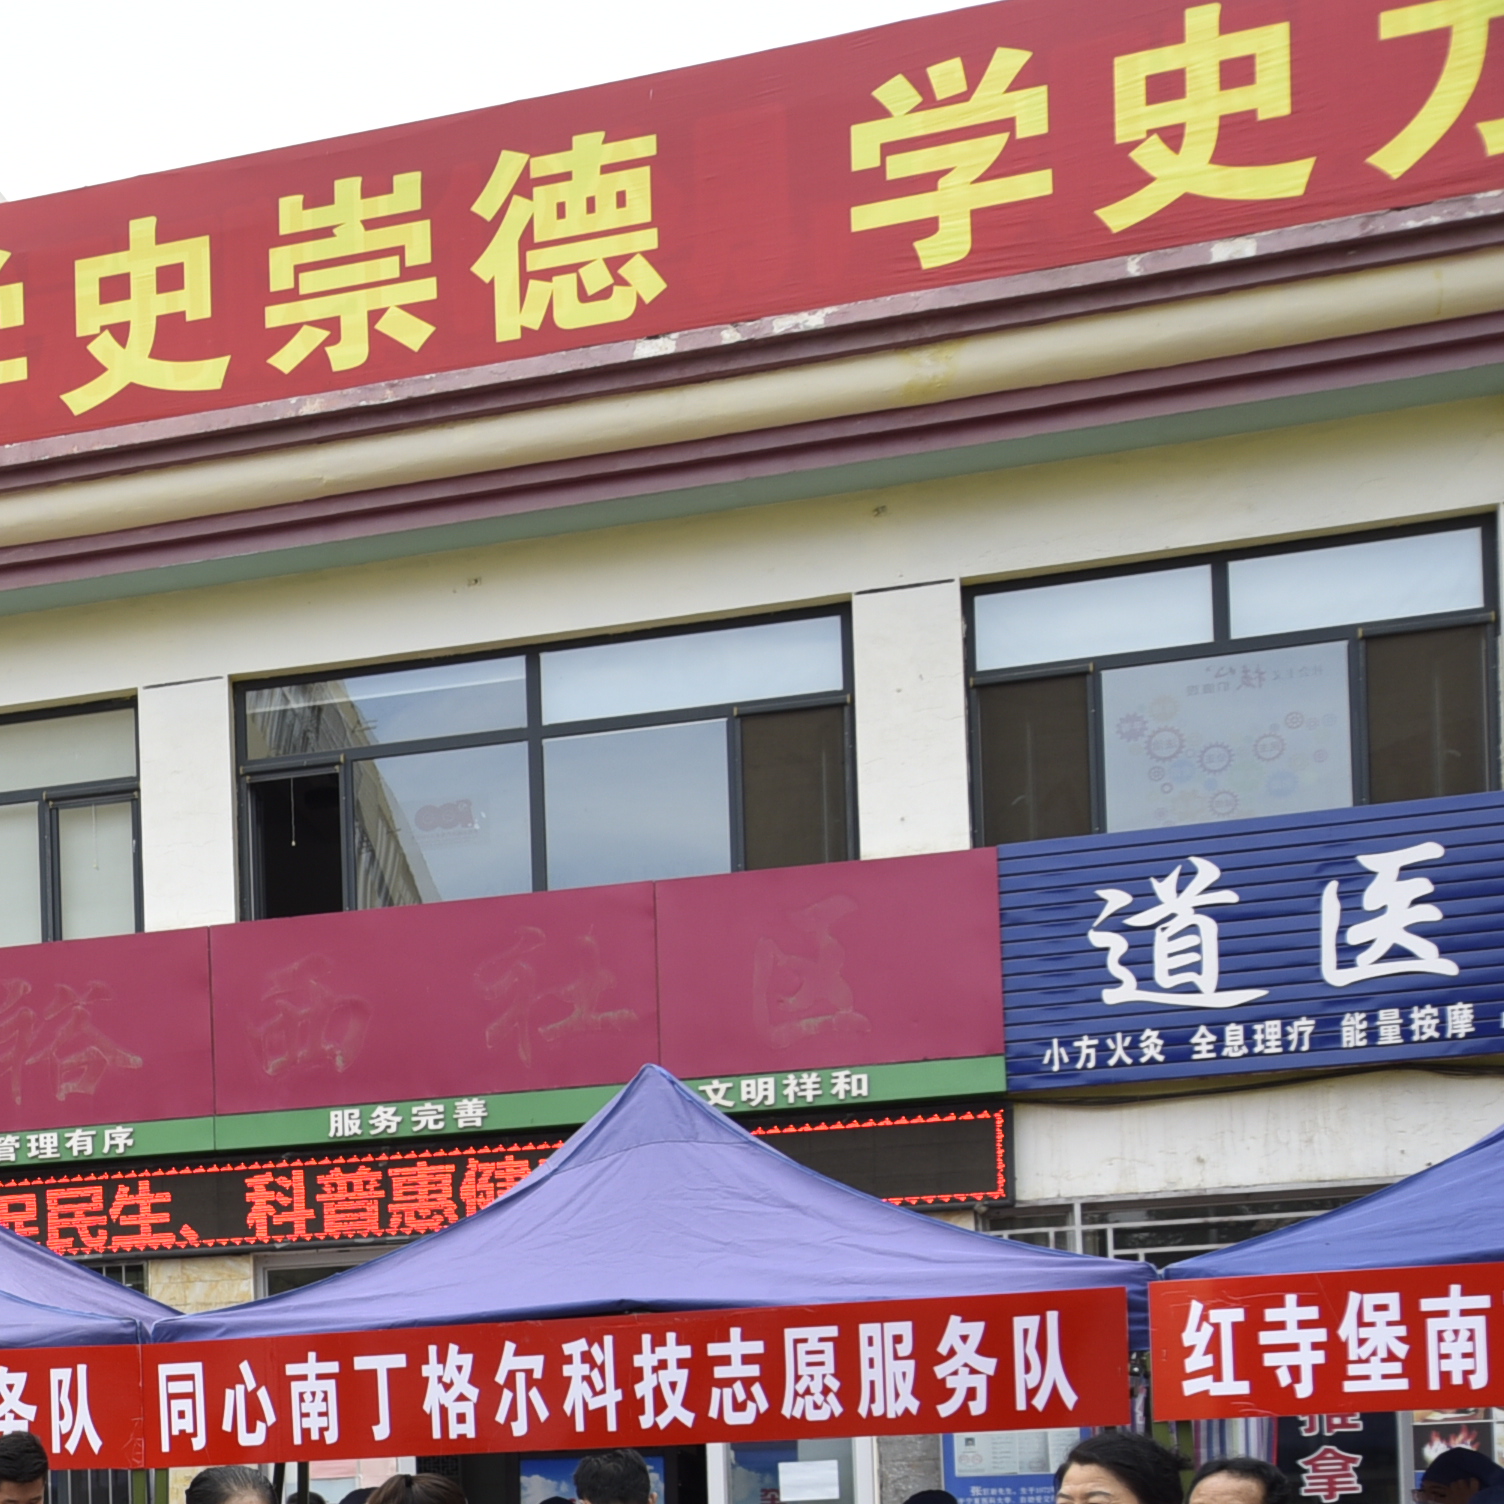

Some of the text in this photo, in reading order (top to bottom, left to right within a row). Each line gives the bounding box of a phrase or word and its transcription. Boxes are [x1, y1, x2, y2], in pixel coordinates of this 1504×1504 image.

[1088, 841, 1460, 1008] 道医
[1043, 1002, 1475, 1072] 小方火灸 全息理疗 能量按摩
[328, 1097, 489, 1138] 服务完善
[698, 1070, 869, 1108] 文明祥和
[157, 1309, 1081, 1454] 同心南丁格尔科技志愿服务队
[1181, 1284, 1492, 1398] 红寺堡南
